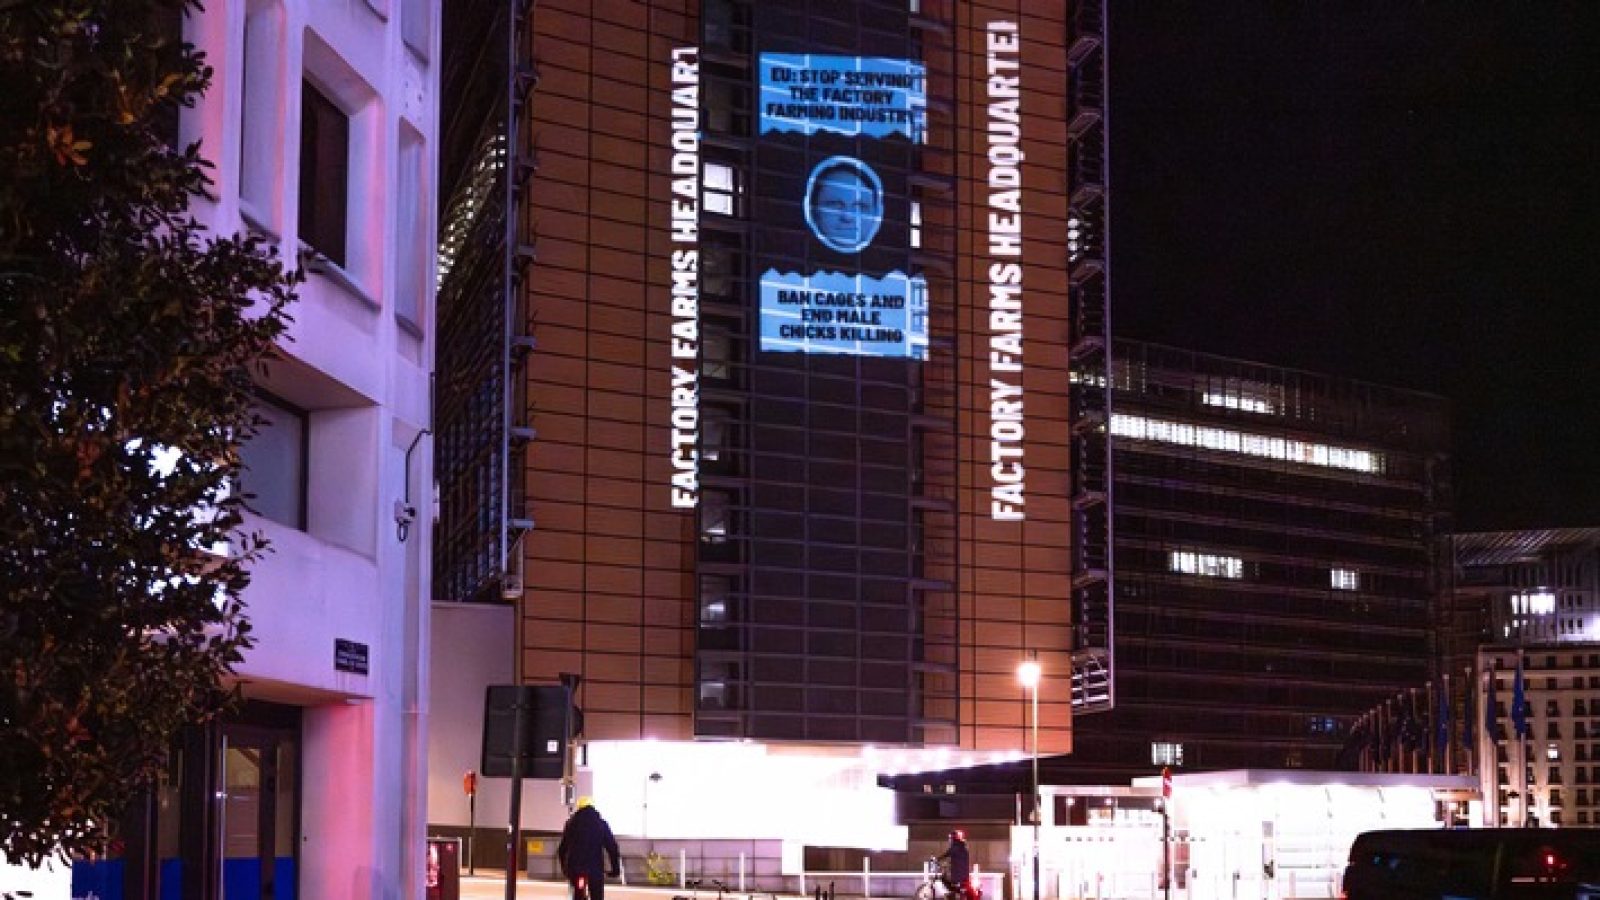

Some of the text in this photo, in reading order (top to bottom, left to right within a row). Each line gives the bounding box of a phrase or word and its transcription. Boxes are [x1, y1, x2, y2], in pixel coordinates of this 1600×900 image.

[771, 67, 914, 89] EU: STOP SERVING
[790, 86, 894, 104] THE FACTORY
[766, 103, 834, 120] FARMING
[671, 250, 698, 359] FARMS
[777, 290, 905, 310] BAN CAGES AND
[801, 308, 881, 326] END MALE
[988, 263, 1023, 372] FARMS
[780, 324, 903, 343] CHICKS KILLING
[671, 364, 699, 508] FACTORY
[990, 379, 1025, 521] FACTORY
